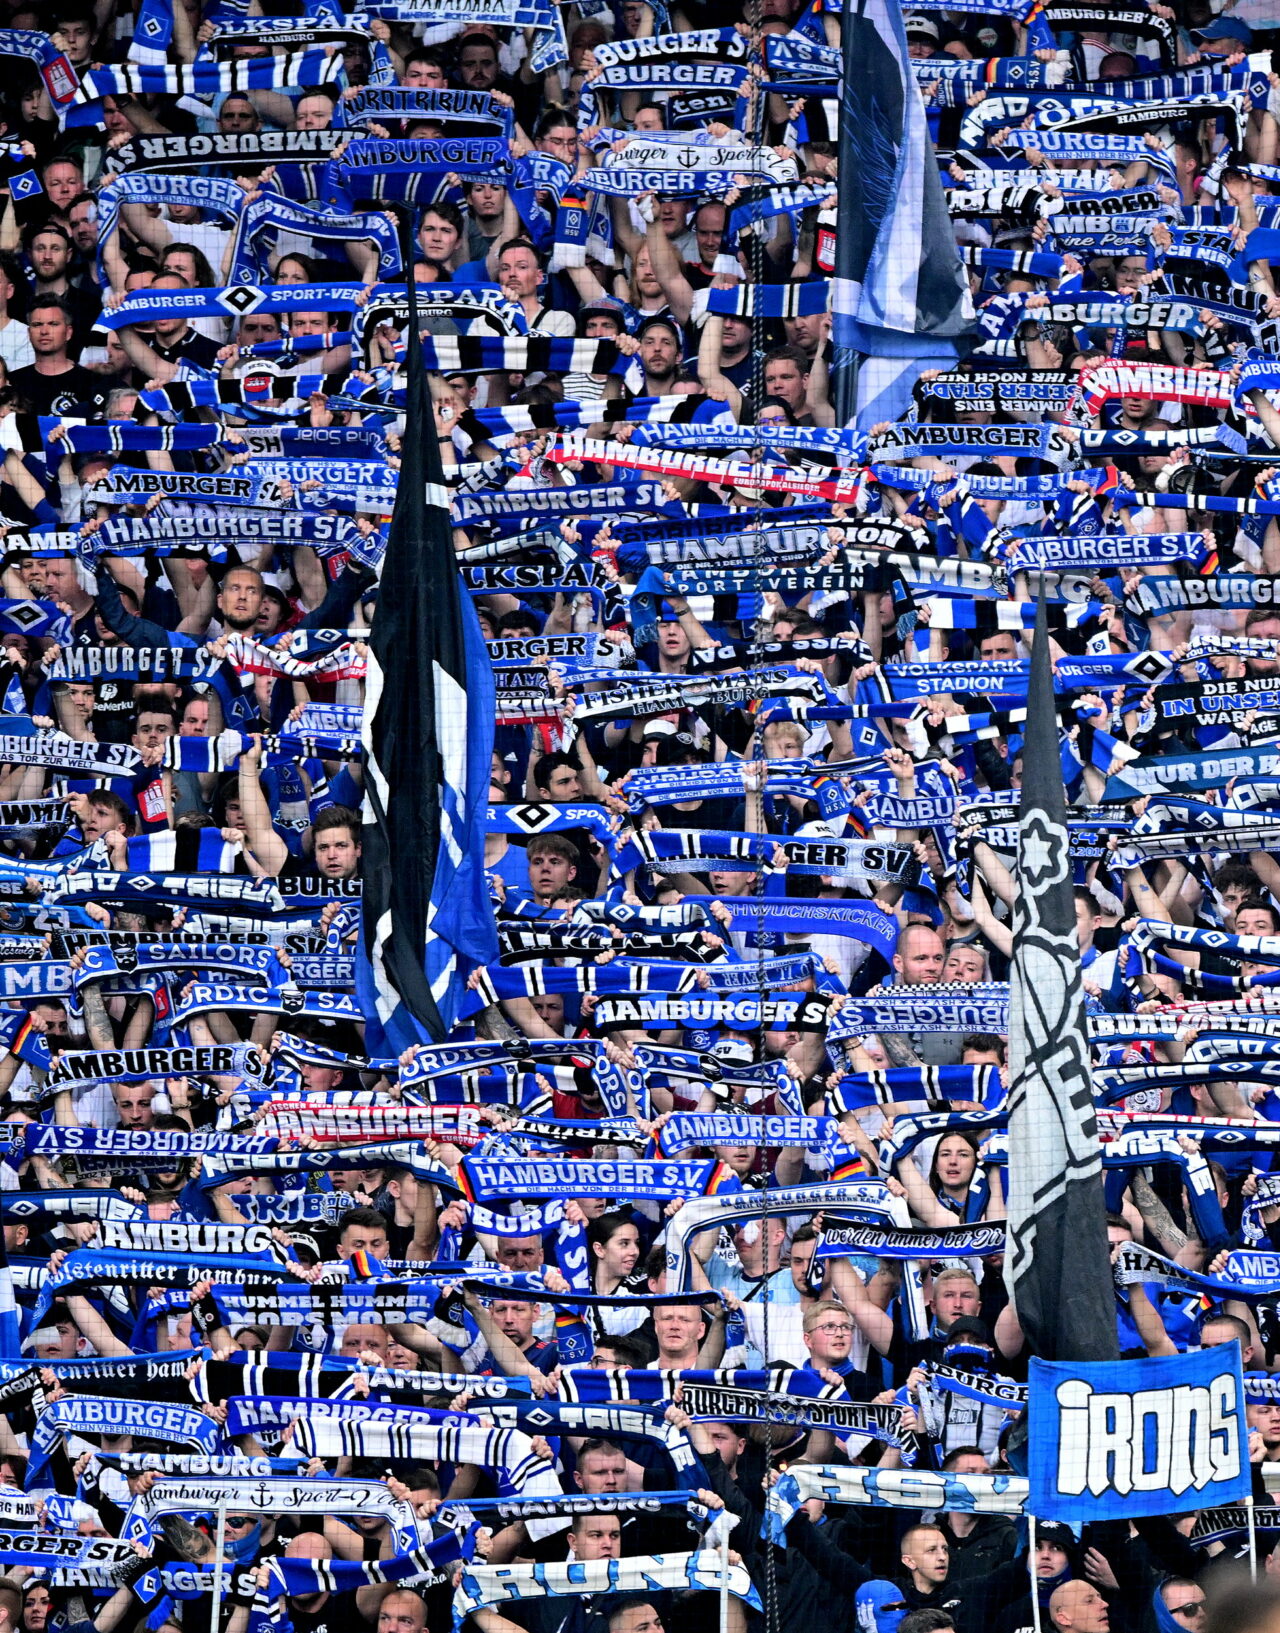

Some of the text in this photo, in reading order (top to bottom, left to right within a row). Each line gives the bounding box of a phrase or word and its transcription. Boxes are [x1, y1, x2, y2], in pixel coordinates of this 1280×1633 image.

[259, 32, 315, 43] HAMBURG
[103, 295, 207, 317] HAMBURGER
[953, 400, 992, 412] EINS
[642, 423, 815, 446] HAMBURGER
[108, 516, 354, 543] HAMBURGER SV
[917, 676, 1004, 692] STADION
[1202, 679, 1232, 696] DIE
[1162, 697, 1194, 718] IN
[65, 759, 96, 770] WELT
[107, 745, 140, 768] SV
[1201, 758, 1254, 780] DER
[863, 846, 907, 873] SV
[149, 944, 271, 968] SAILORS
[585, 999, 797, 1027] HAMBURGER
[256, 1108, 480, 1137] HAMBURGER
[664, 1115, 818, 1146] HAMBURGER
[38, 1124, 269, 1156] HAMBURGER S.V.
[476, 1163, 702, 1190] HAMBURGER S.V.
[826, 1226, 886, 1247] werden
[886, 1228, 942, 1249] immer
[945, 1226, 982, 1248] bei
[221, 1294, 431, 1310] HUMMEL HUMMEL
[120, 1455, 271, 1477] HAMBURG
[143, 1484, 240, 1510] Hamburger
[93, 1541, 136, 1563] SV
